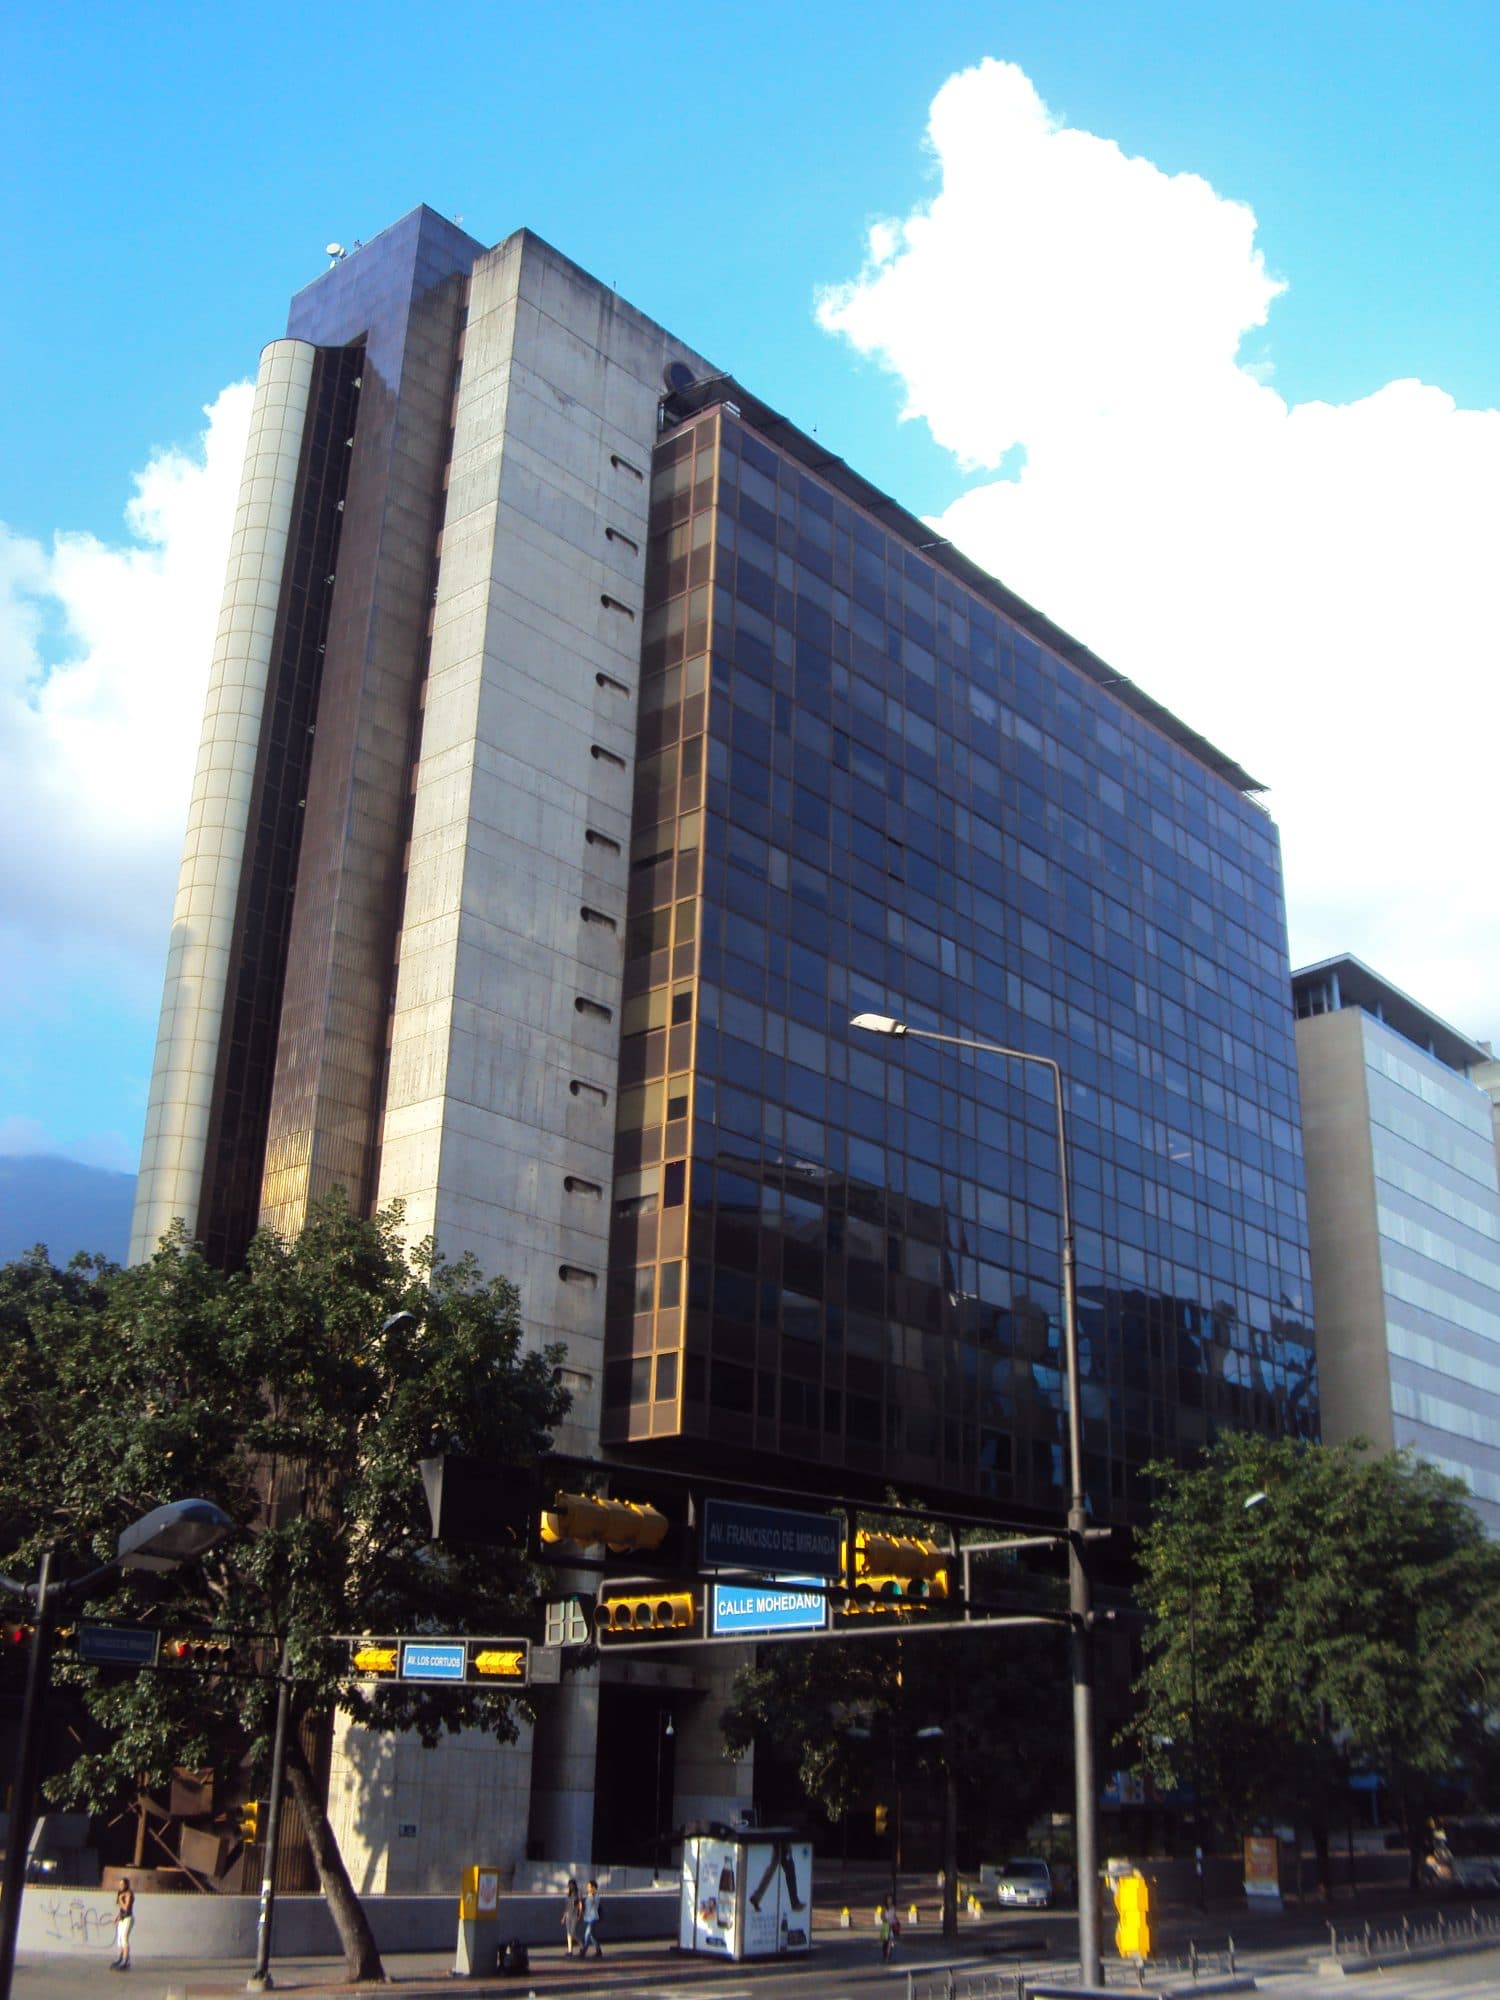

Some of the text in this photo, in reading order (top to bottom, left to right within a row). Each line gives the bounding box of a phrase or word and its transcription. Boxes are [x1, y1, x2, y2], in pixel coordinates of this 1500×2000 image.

[727, 1525, 780, 1549] FRANCISCO
[782, 1531, 795, 1551] DE
[796, 1533, 835, 1554] MIRANDA
[718, 1593, 821, 1616] CALLE MOHEDANO
[417, 1655, 430, 1666] LOS
